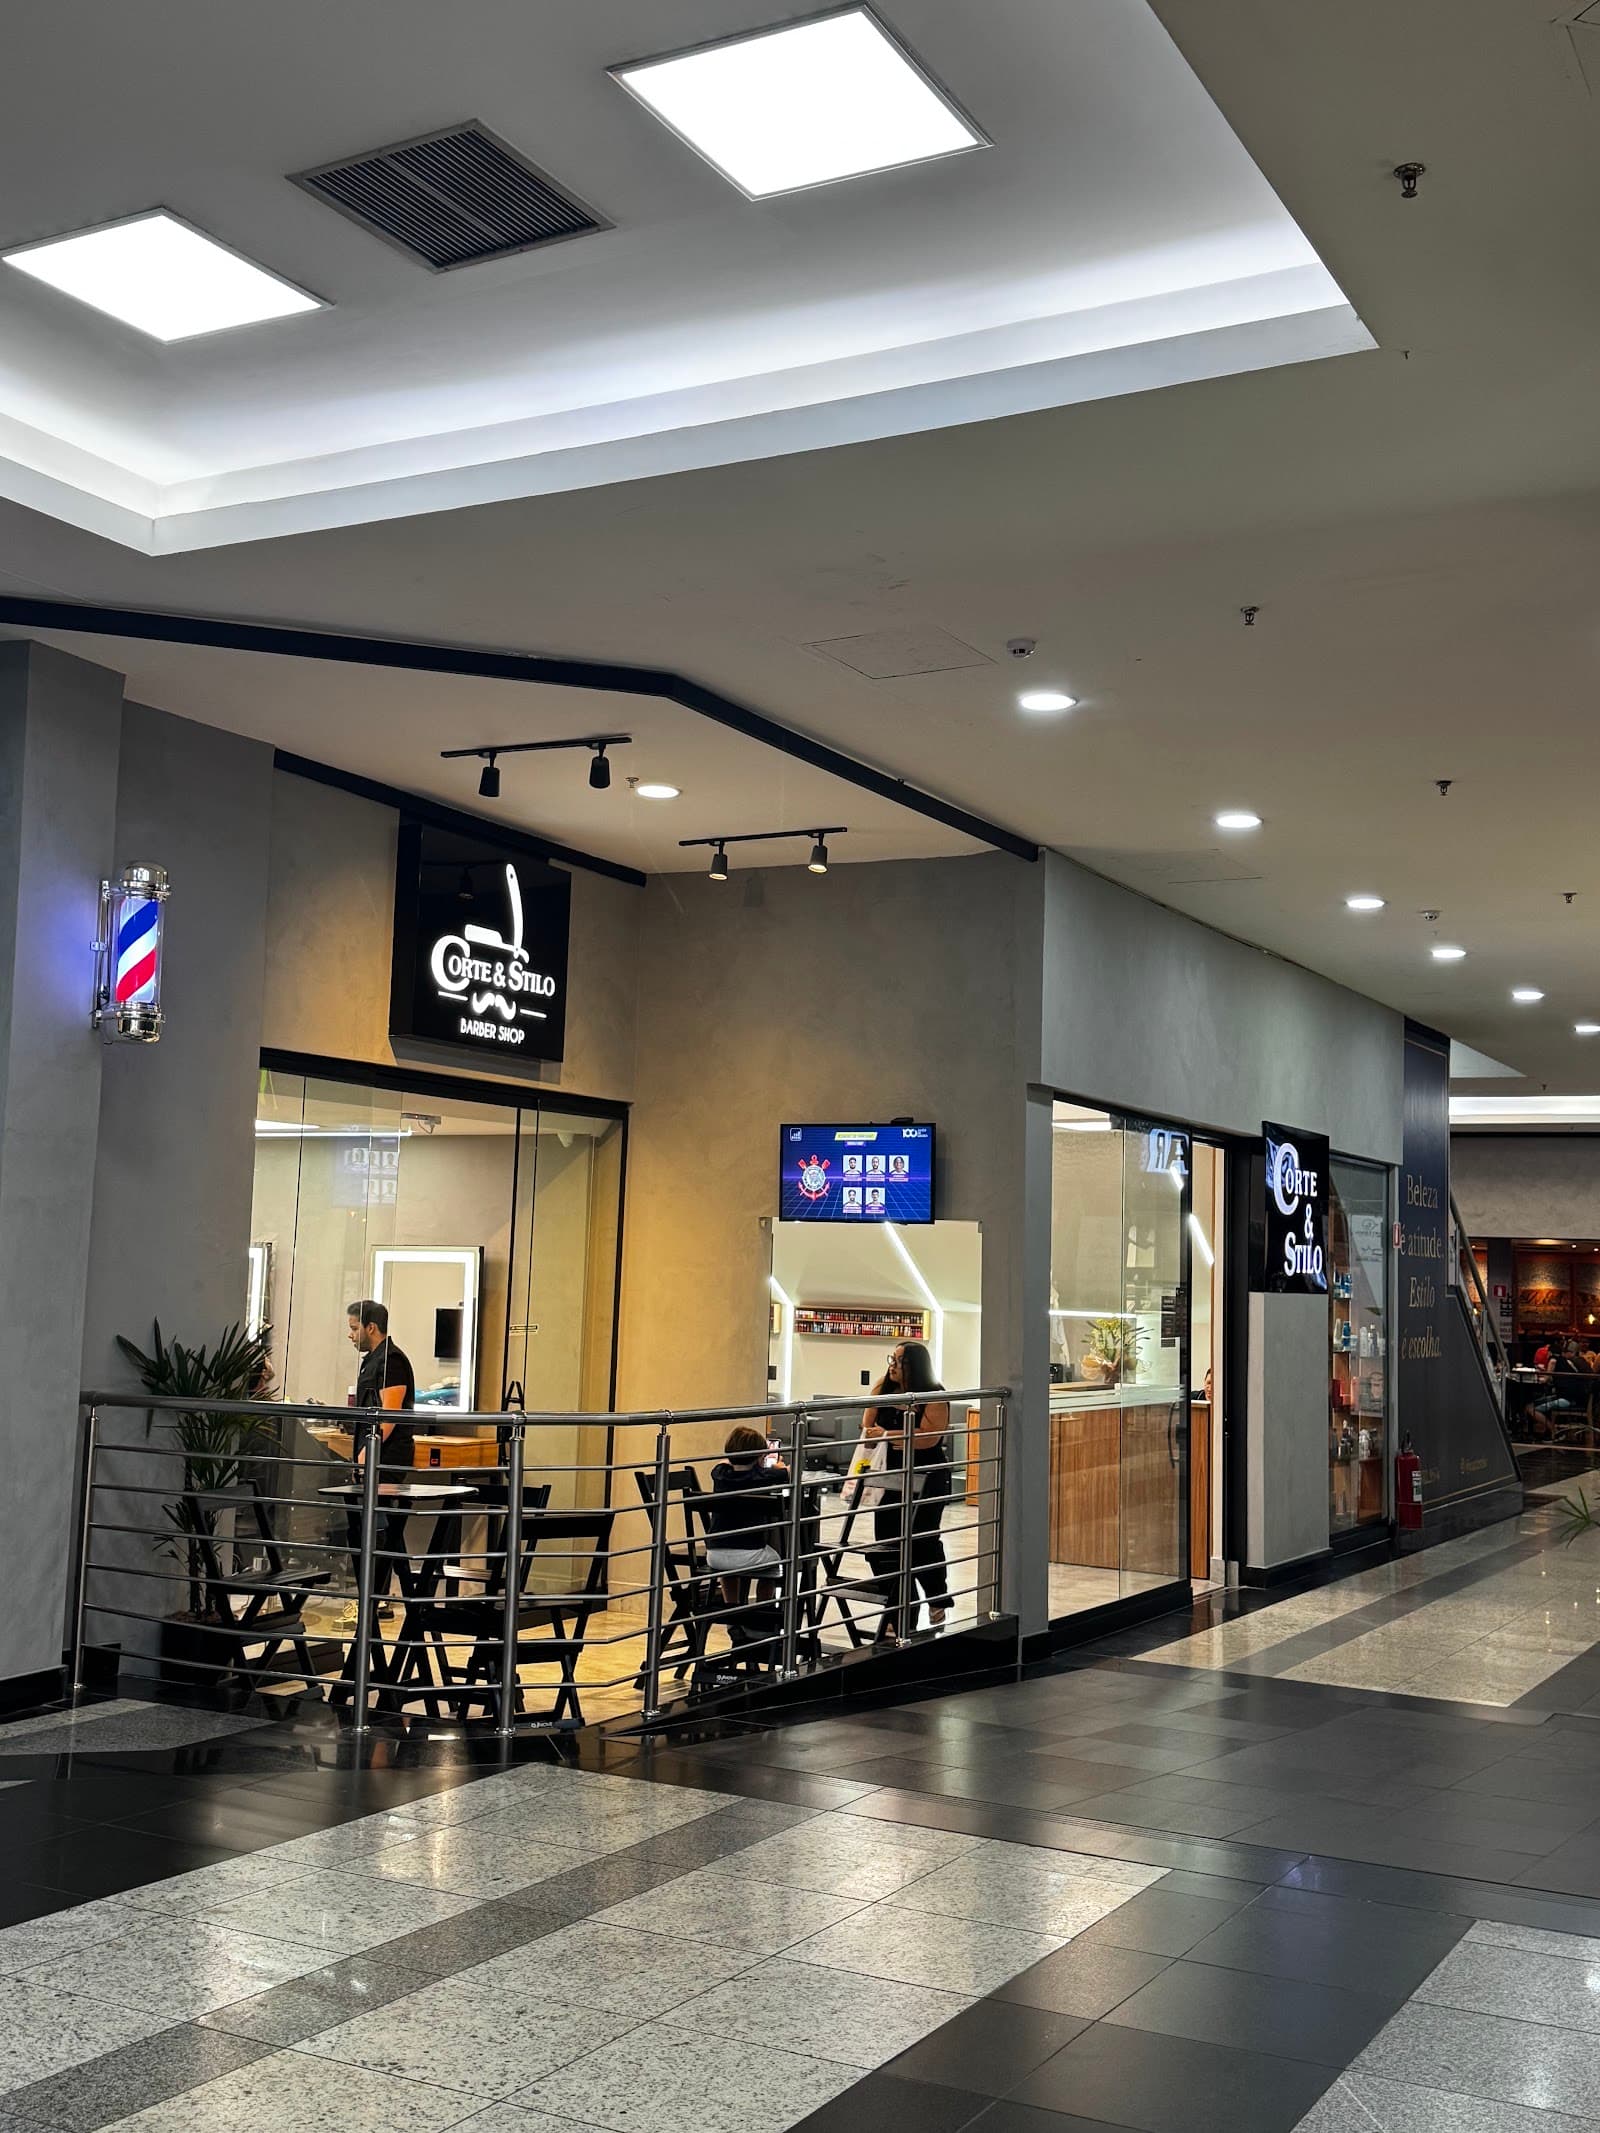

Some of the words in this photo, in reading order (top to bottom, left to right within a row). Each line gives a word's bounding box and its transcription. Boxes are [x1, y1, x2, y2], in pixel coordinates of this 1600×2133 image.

[431, 934, 492, 992] CORTE
[492, 961, 506, 988] &
[508, 960, 556, 997] STILO
[460, 1018, 496, 1040] BARBER
[498, 1025, 524, 1044] SHOP
[902, 1128, 918, 1138] 100
[1274, 1142, 1318, 1216] CORTE
[1407, 1174, 1439, 1209] Beleza
[1304, 1203, 1314, 1239] &
[1283, 1231, 1323, 1277] STILO
[1408, 1276, 1436, 1309] Estilo
